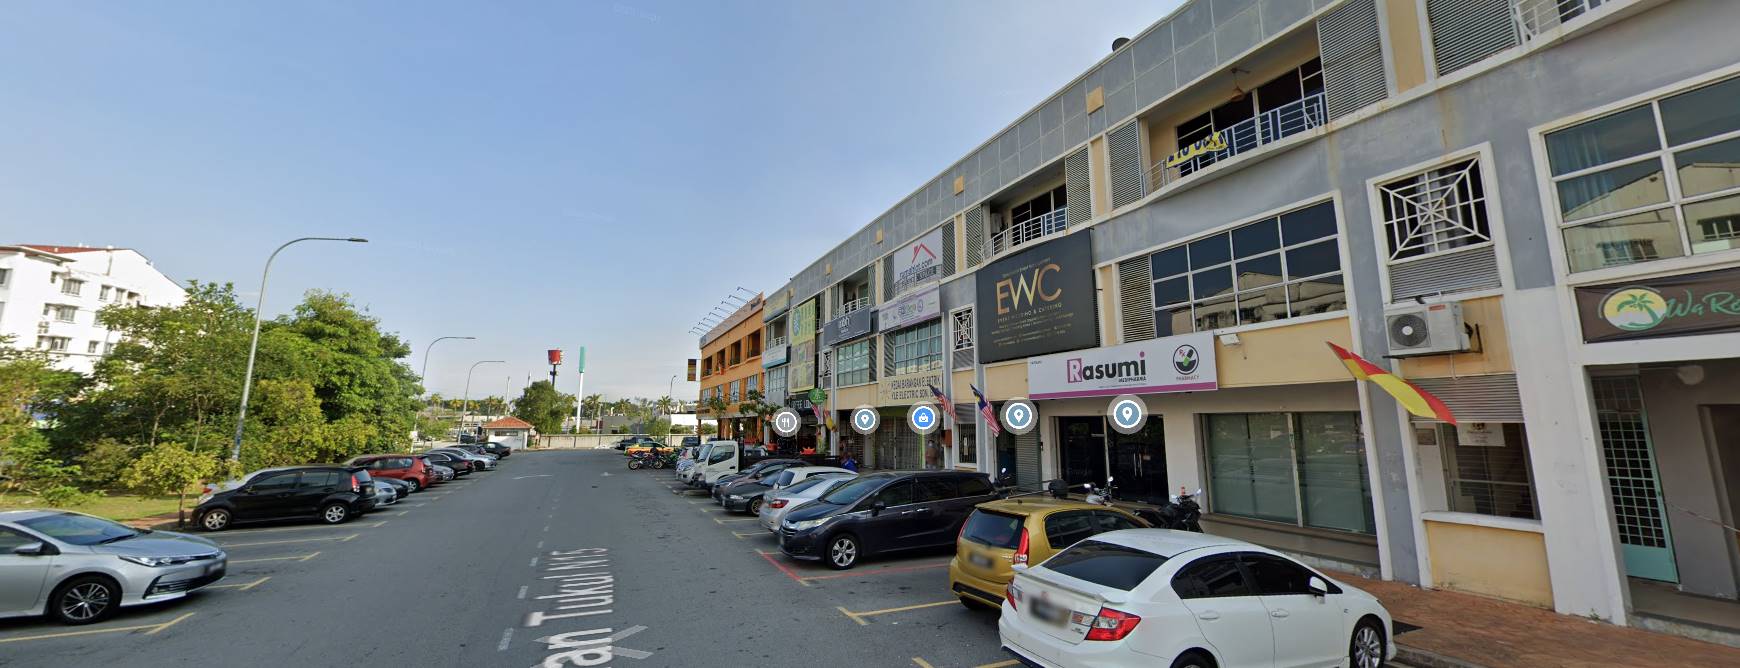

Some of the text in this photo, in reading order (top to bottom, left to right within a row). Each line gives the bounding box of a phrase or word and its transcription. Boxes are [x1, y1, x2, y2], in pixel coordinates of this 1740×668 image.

[996, 263, 1062, 315] EWC
[1067, 351, 1146, 383] Rasumi
[525, 572, 614, 627] Tukul
